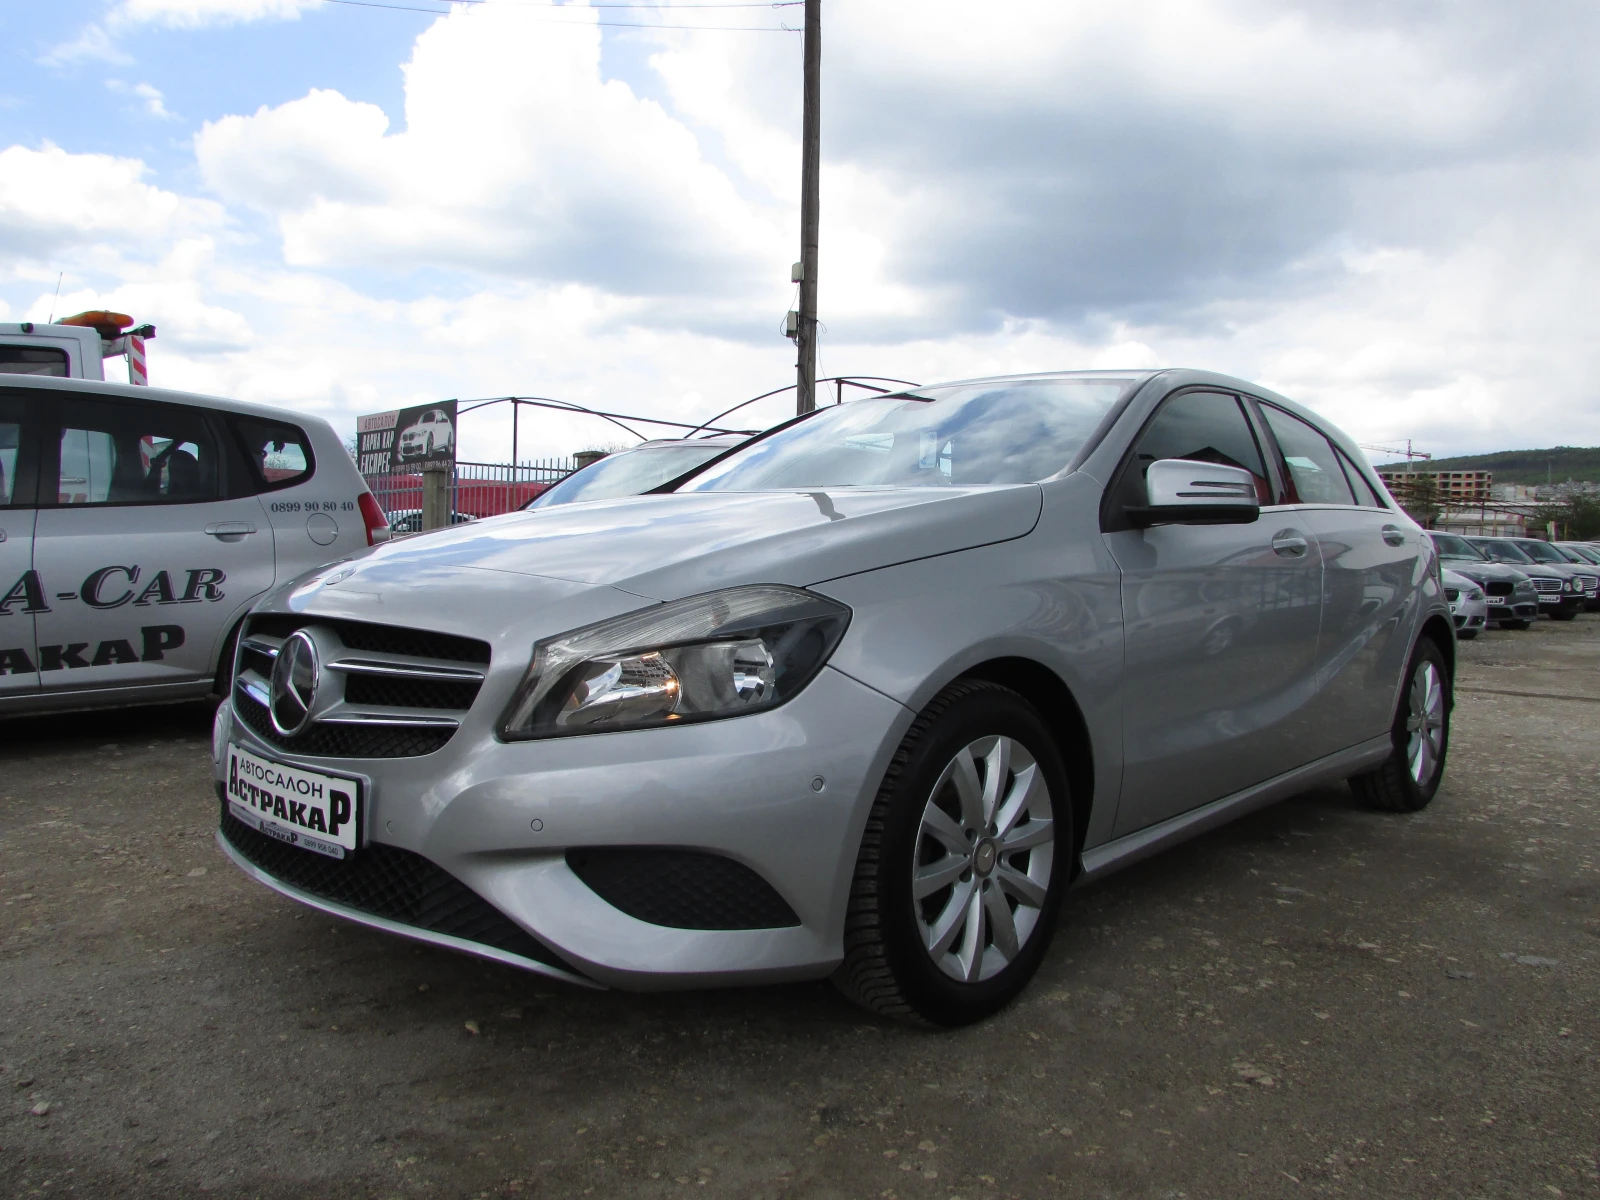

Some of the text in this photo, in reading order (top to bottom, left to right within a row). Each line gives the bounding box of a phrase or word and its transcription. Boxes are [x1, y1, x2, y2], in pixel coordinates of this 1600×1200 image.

[364, 415, 396, 430] АВТОСАЛОН
[382, 431, 395, 449] КАР
[361, 452, 391, 475] ЕКСПРЕС
[271, 501, 354, 513] 0899 90 80 40
[240, 757, 323, 798] АВТОСАЛОН
[229, 754, 351, 836] АСТРАКАР
